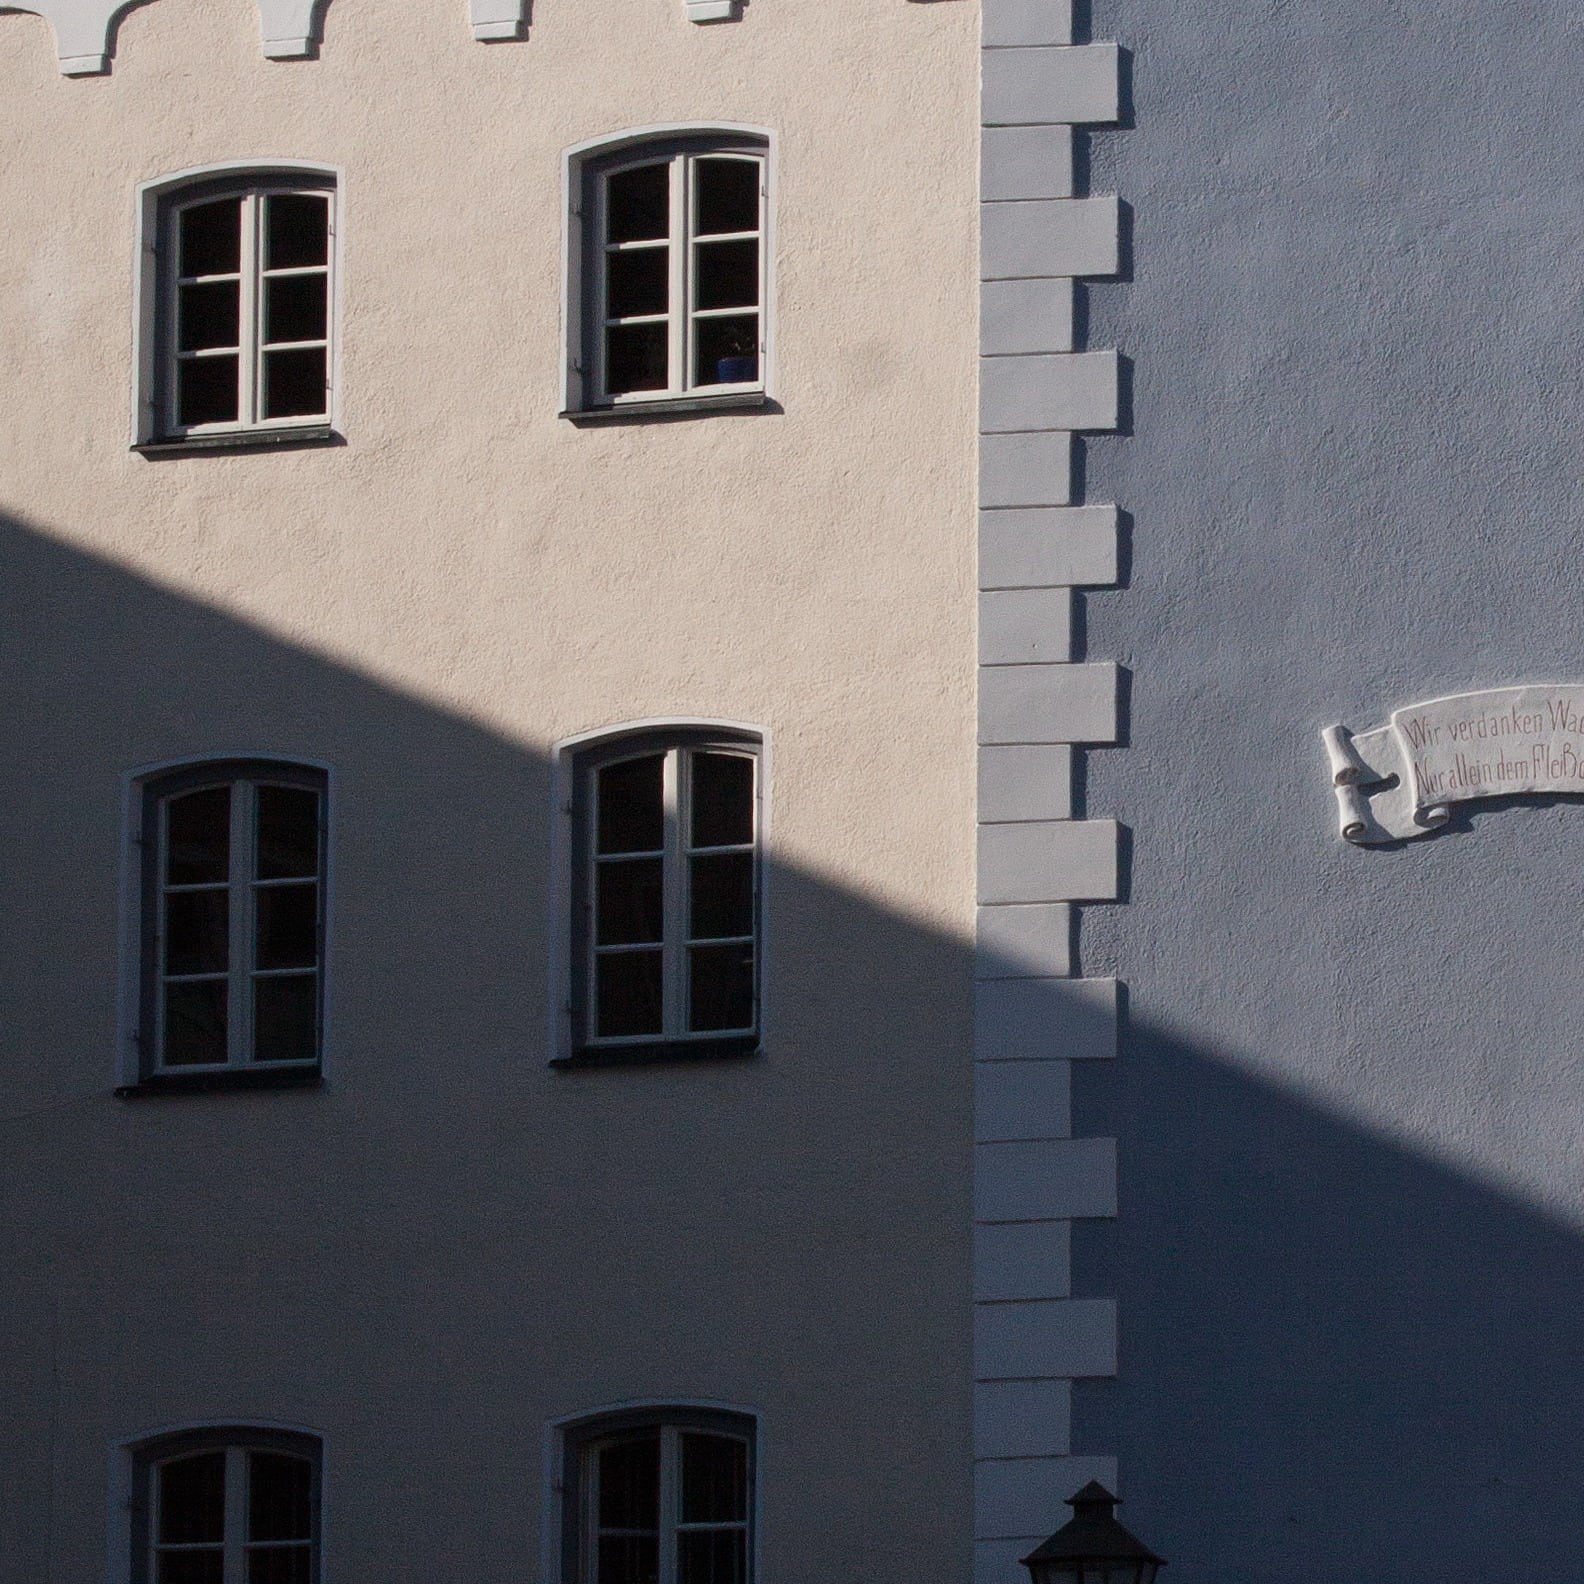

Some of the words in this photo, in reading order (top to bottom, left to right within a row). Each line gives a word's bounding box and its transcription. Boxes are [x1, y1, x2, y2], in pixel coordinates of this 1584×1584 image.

[1404, 714, 1441, 751] Wir
[1448, 705, 1543, 742] verdanken
[1415, 760, 1446, 795] Nur
[1449, 751, 1495, 789] allein
[1496, 747, 1529, 781] dem
[1532, 742, 1577, 780] Fleiß
